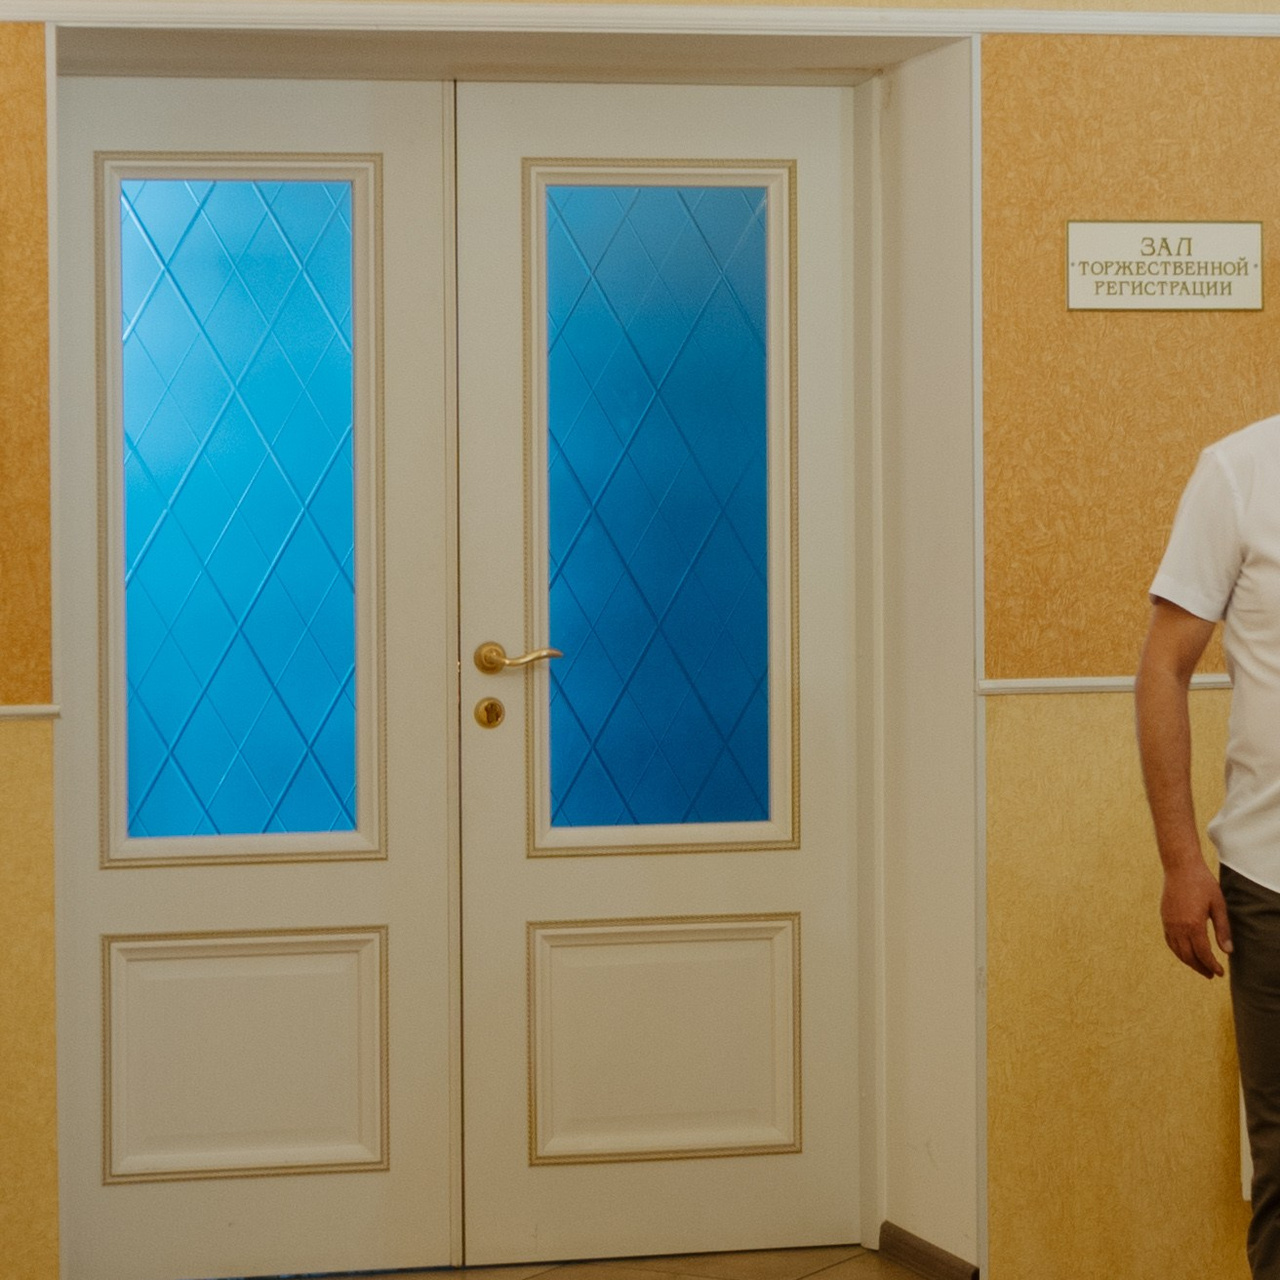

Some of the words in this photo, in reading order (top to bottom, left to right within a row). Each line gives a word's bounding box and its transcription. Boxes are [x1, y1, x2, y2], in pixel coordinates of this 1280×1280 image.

[1140, 237, 1193, 257] ЗАЛ
[1078, 257, 1249, 276] ТОРЖЕСТВЕННОЙ
[1094, 280, 1233, 298] РЕГИСТРАЦИИ
